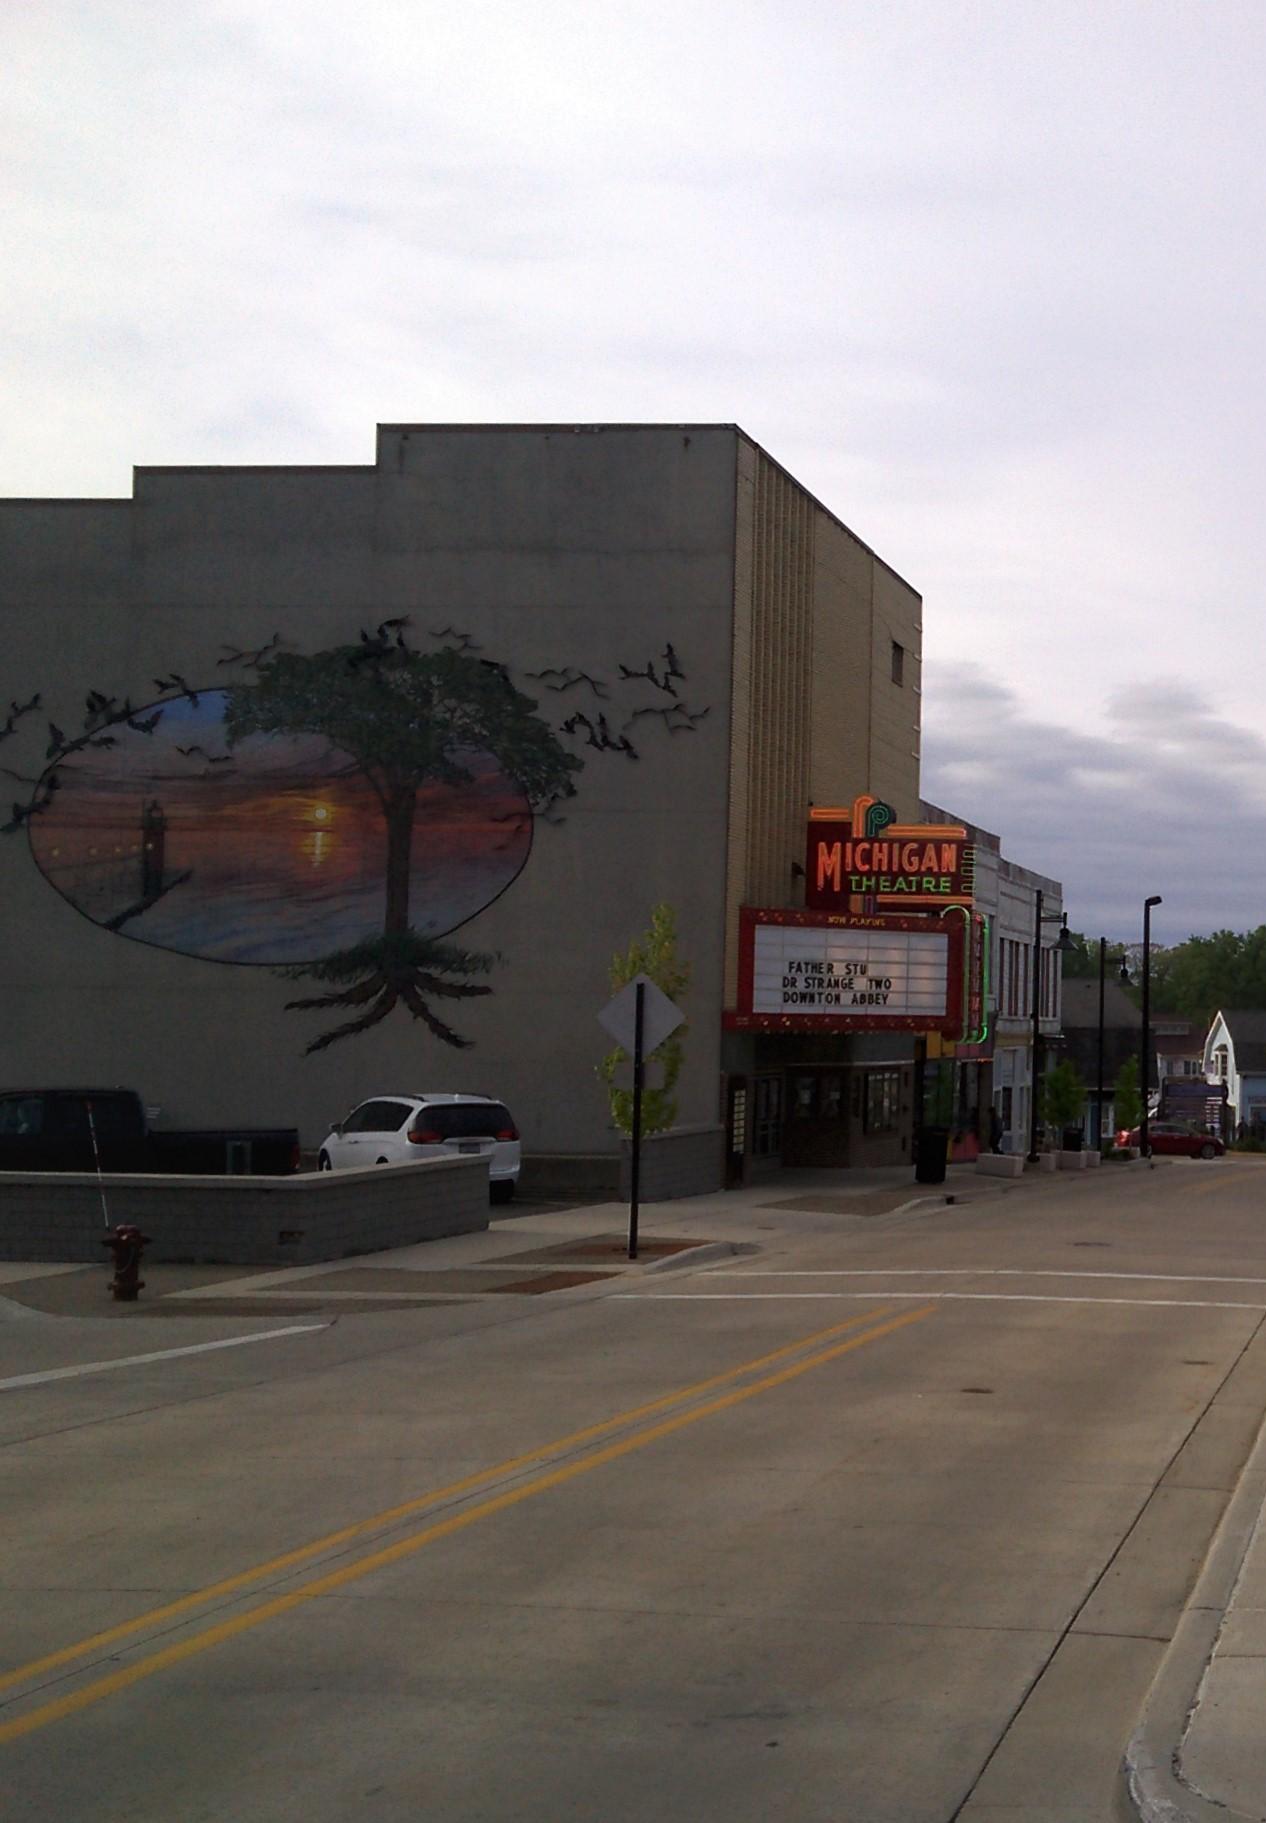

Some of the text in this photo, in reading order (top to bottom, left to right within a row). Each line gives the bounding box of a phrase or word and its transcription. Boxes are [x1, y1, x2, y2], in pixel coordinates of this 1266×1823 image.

[817, 841, 957, 892] MICHIGAN
[849, 875, 951, 893] THEATRE
[788, 961, 867, 976] FATHER STU
[782, 977, 892, 991] DR STRANGE TWO
[782, 992, 889, 1005] DOWNTON ABBEY
